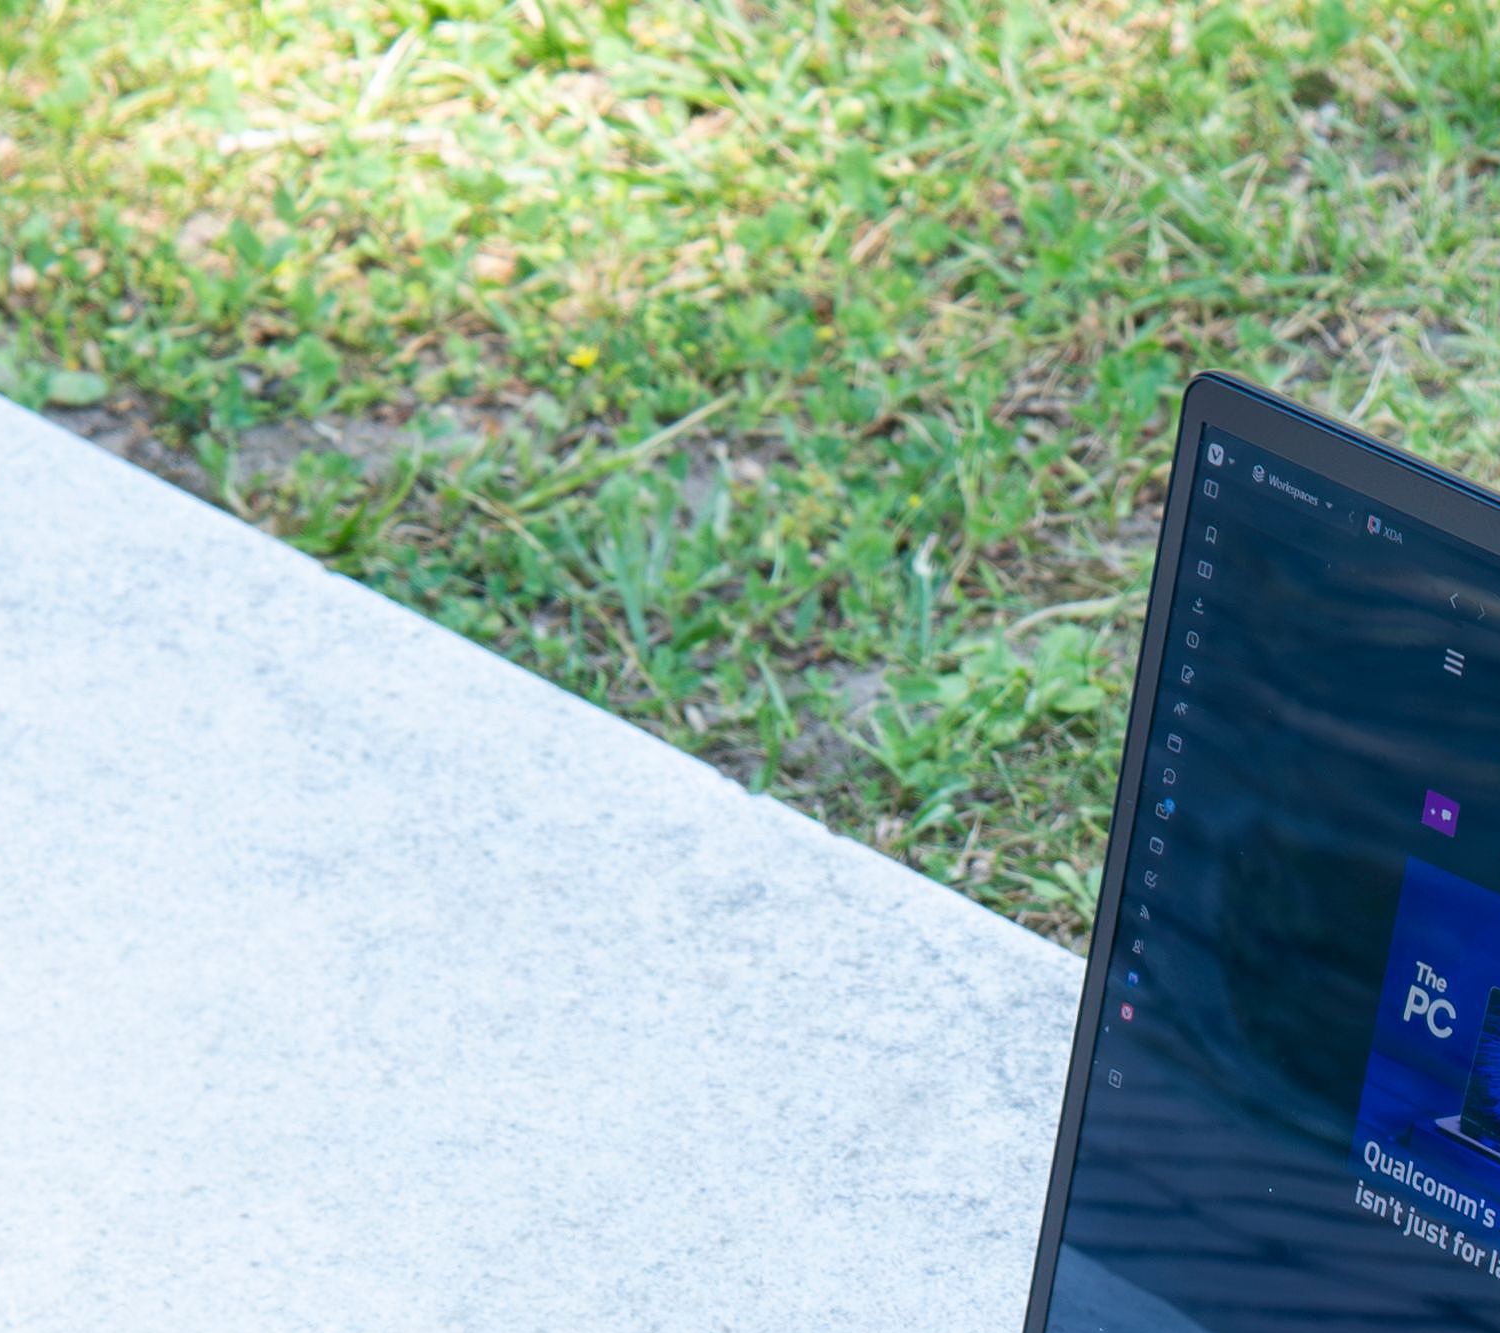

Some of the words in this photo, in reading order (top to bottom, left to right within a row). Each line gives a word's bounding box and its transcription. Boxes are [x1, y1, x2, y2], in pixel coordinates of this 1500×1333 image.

[1268, 473, 1319, 506] Workspaces
[1382, 525, 1403, 545] XDA
[1415, 960, 1448, 993] The
[1402, 984, 1457, 1039] PC
[1363, 1140, 1496, 1228] Qualcomm's
[1354, 1179, 1404, 1226] isn't
[1402, 1205, 1449, 1250] just
[1452, 1230, 1486, 1267] for
